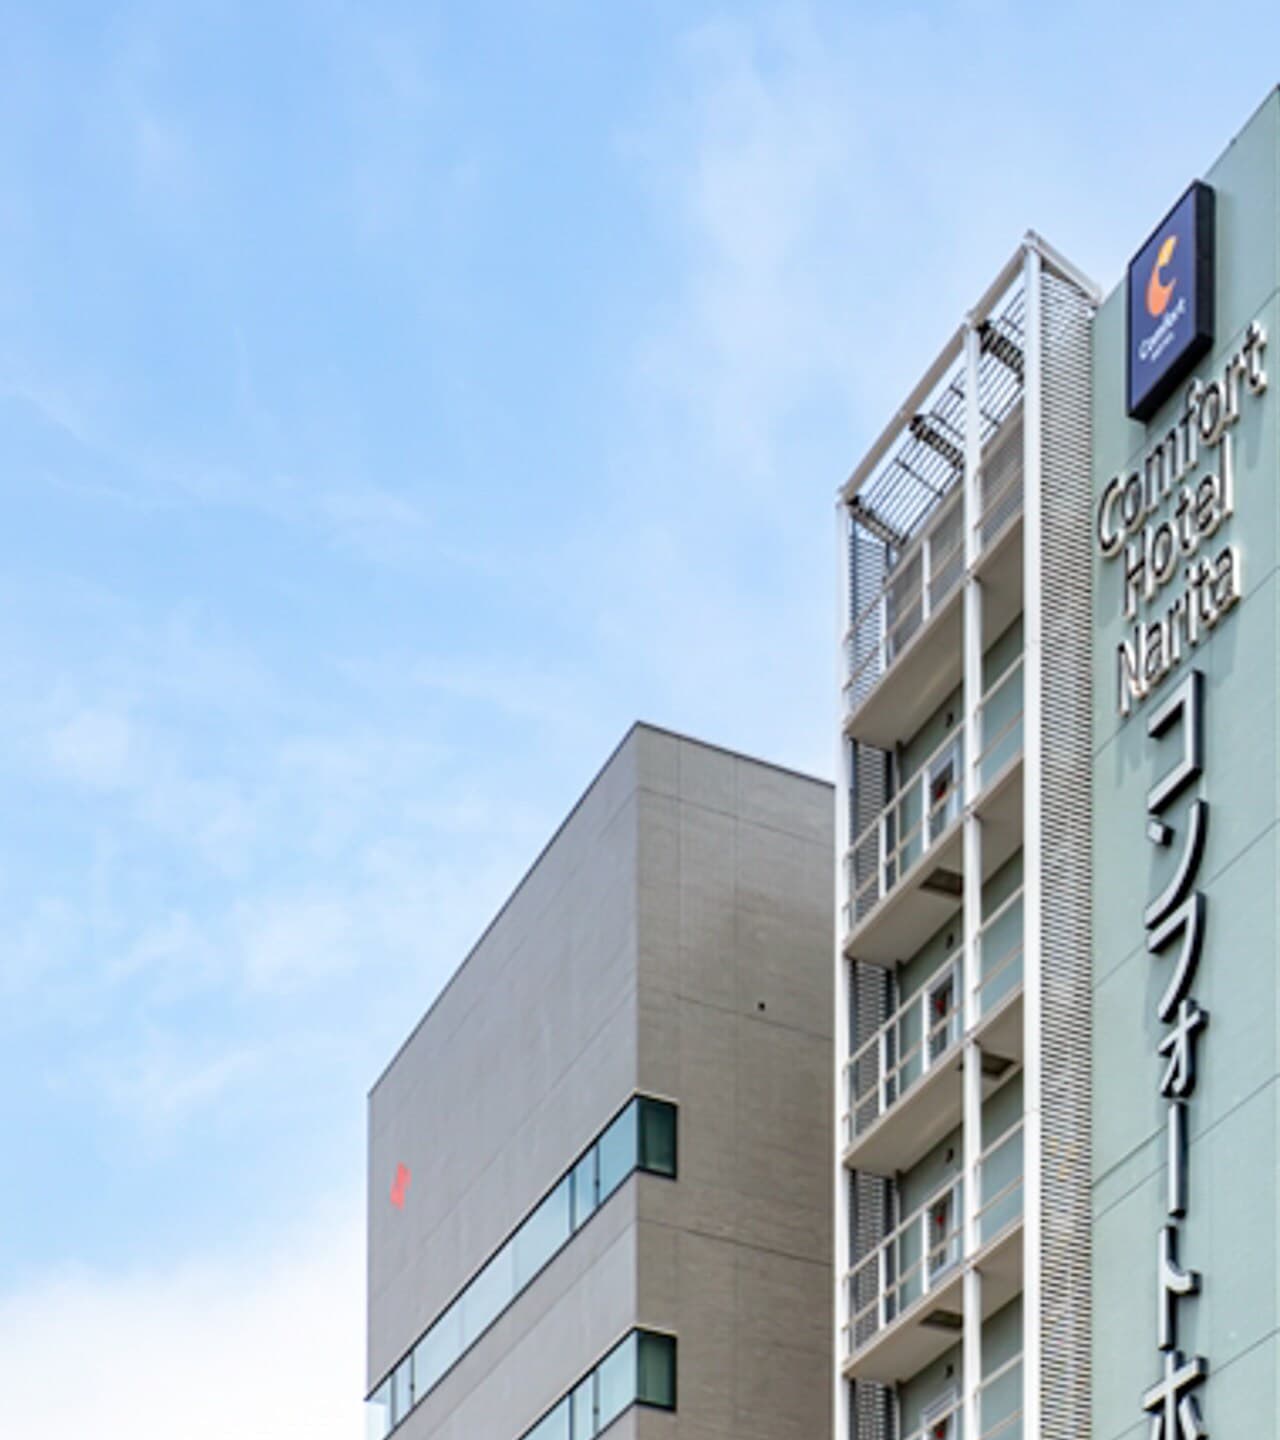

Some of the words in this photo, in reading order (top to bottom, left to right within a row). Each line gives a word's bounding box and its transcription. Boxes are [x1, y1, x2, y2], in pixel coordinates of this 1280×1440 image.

[1099, 320, 1268, 559] Comfort
[1123, 434, 1234, 620] Hotel
[1116, 543, 1242, 717] Narita
